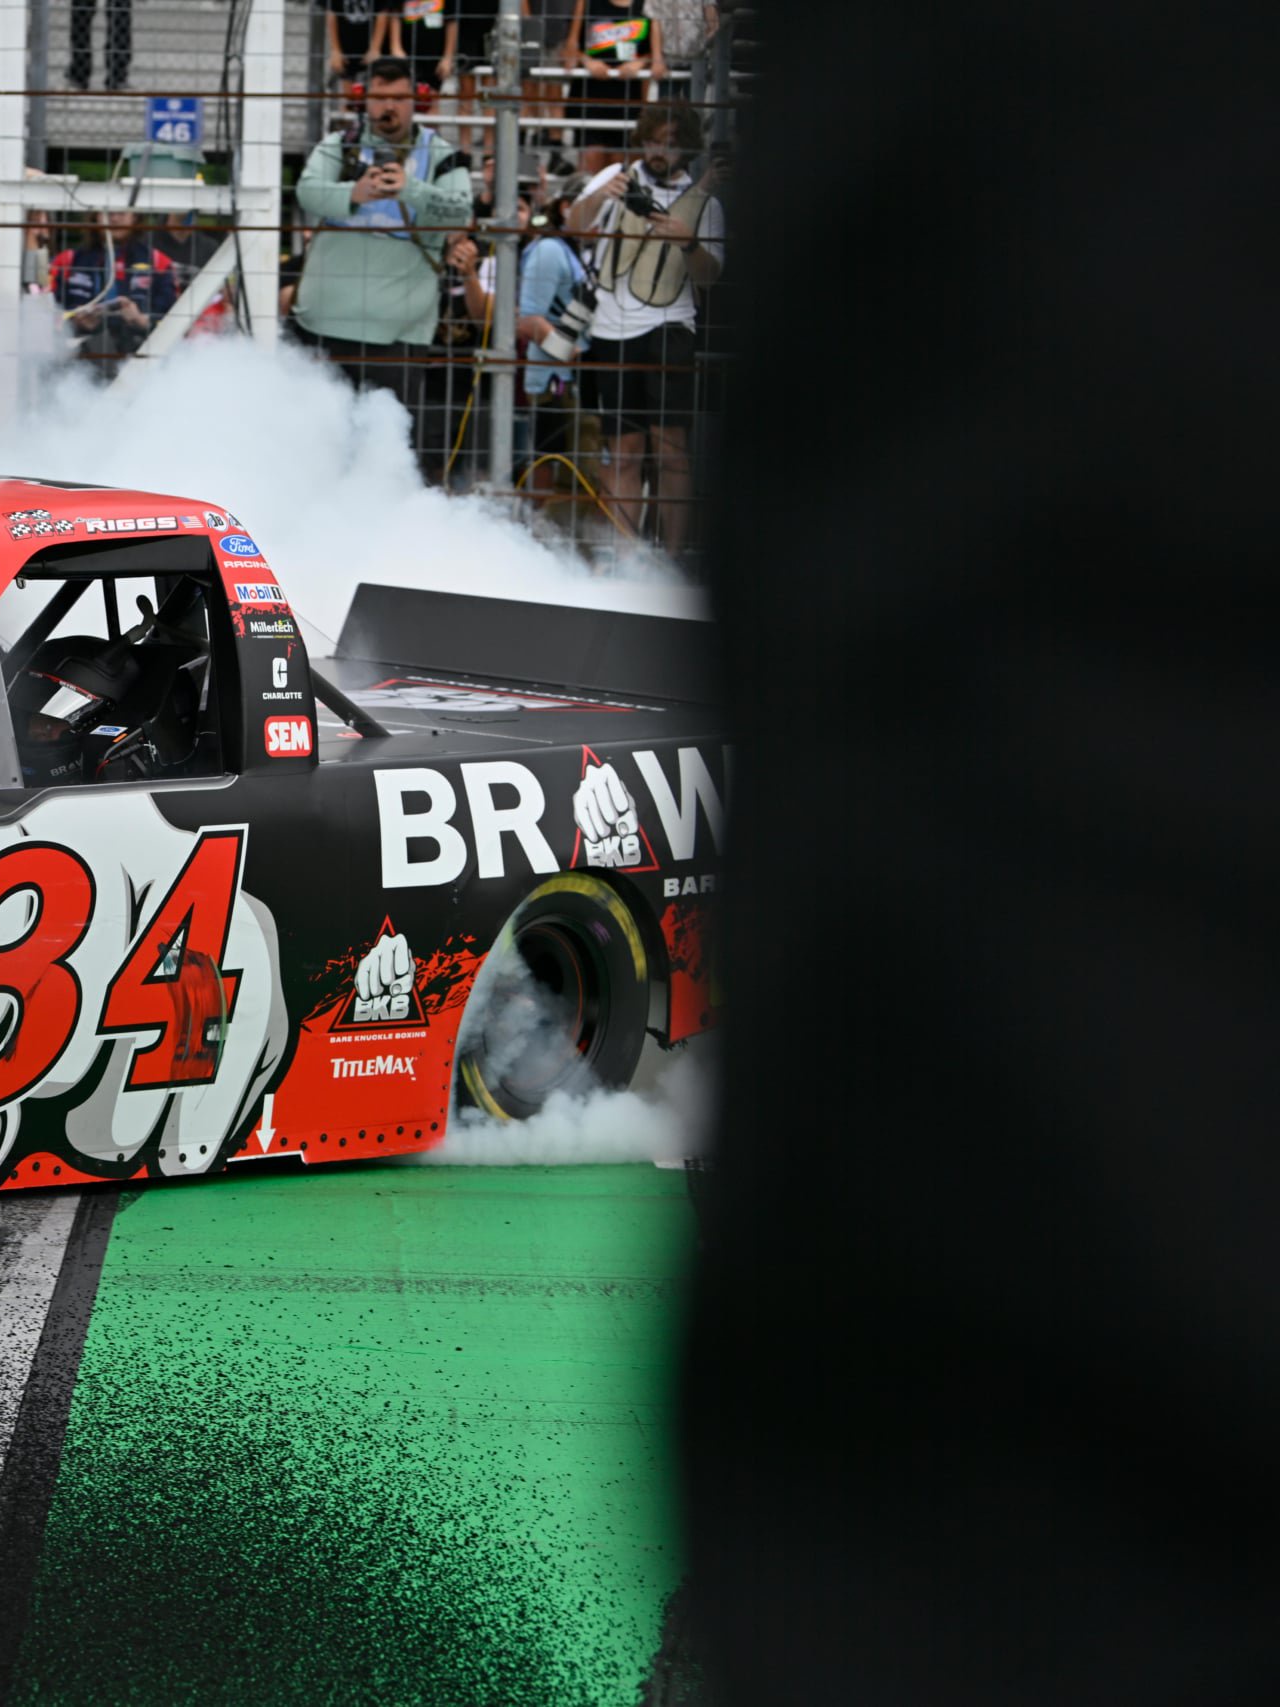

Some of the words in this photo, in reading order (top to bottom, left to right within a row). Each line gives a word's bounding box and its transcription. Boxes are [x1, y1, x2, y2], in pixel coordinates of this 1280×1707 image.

[86, 516, 178, 534] RIGGS
[229, 537, 256, 553] Ford
[237, 586, 271, 600] Mobil
[262, 692, 302, 700] CHARLOTTE
[268, 721, 310, 751] SEM
[354, 1033, 393, 1041] KNUCKLE
